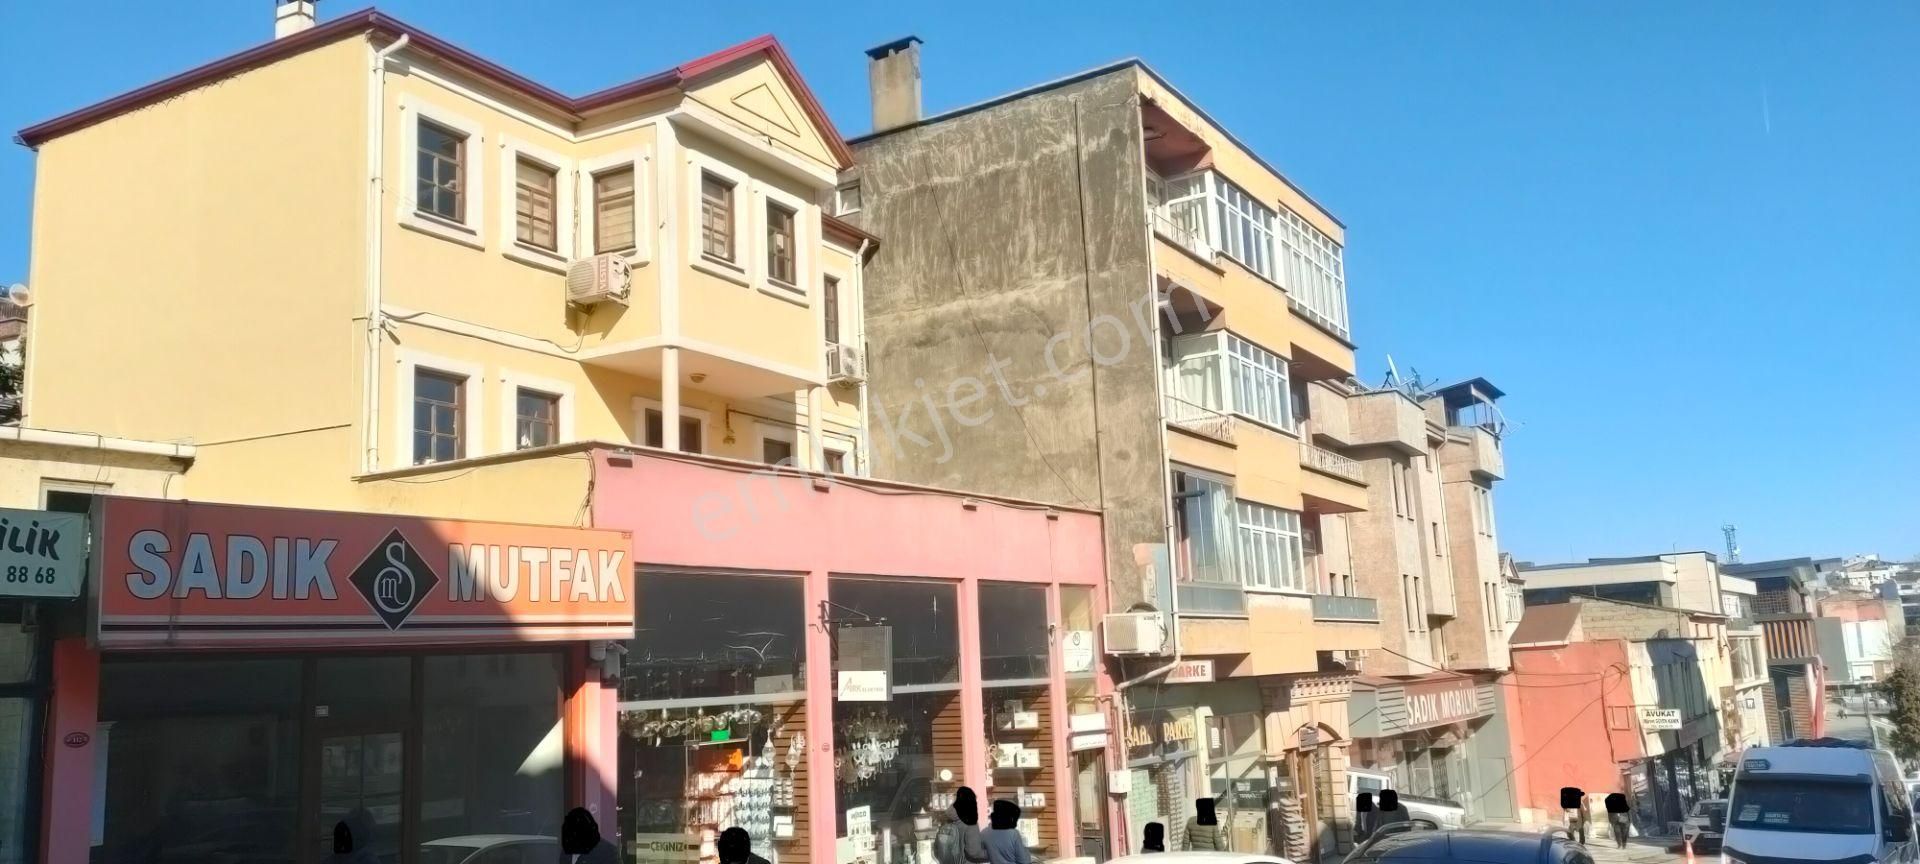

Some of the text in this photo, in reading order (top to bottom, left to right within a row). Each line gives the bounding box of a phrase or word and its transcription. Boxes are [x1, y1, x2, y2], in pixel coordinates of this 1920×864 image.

[6, 565, 56, 585] 88 68
[126, 530, 627, 603] SADIK MUTFAK
[1406, 682, 1480, 726] SADIK MOBİLYA
